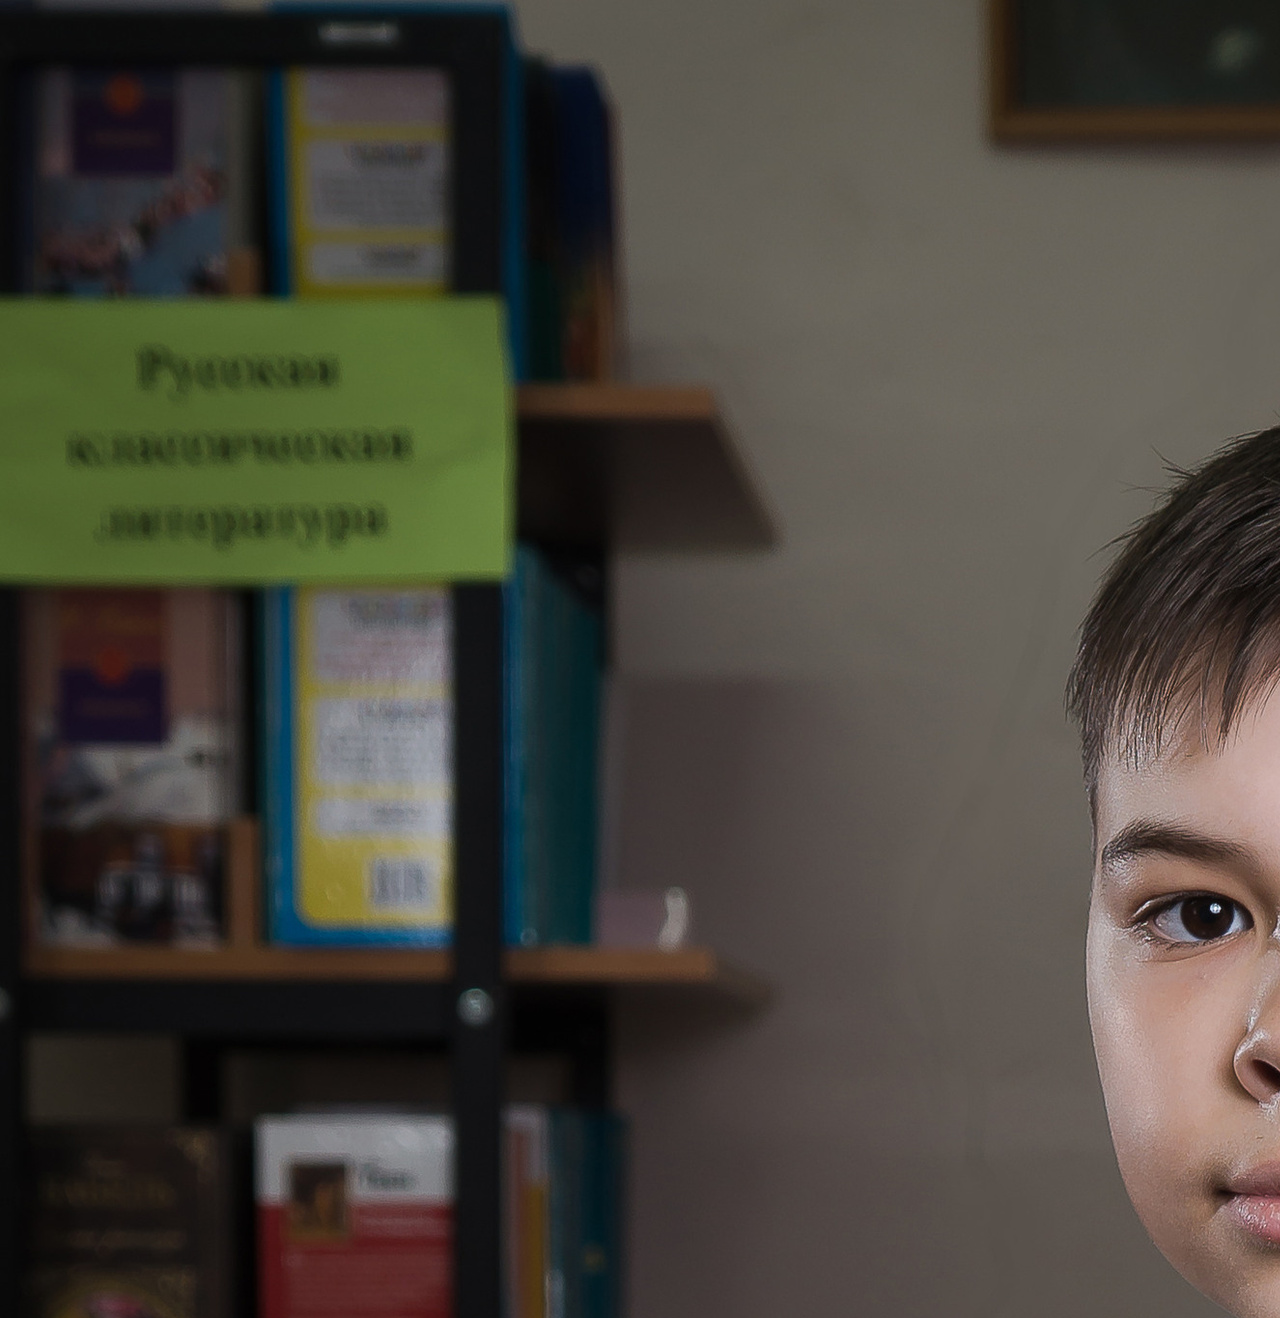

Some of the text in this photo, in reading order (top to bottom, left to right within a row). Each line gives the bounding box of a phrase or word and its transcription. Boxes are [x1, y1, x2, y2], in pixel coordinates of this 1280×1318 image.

[137, 347, 340, 402] Русская
[67, 426, 413, 469] классическая
[96, 500, 388, 547] литература
